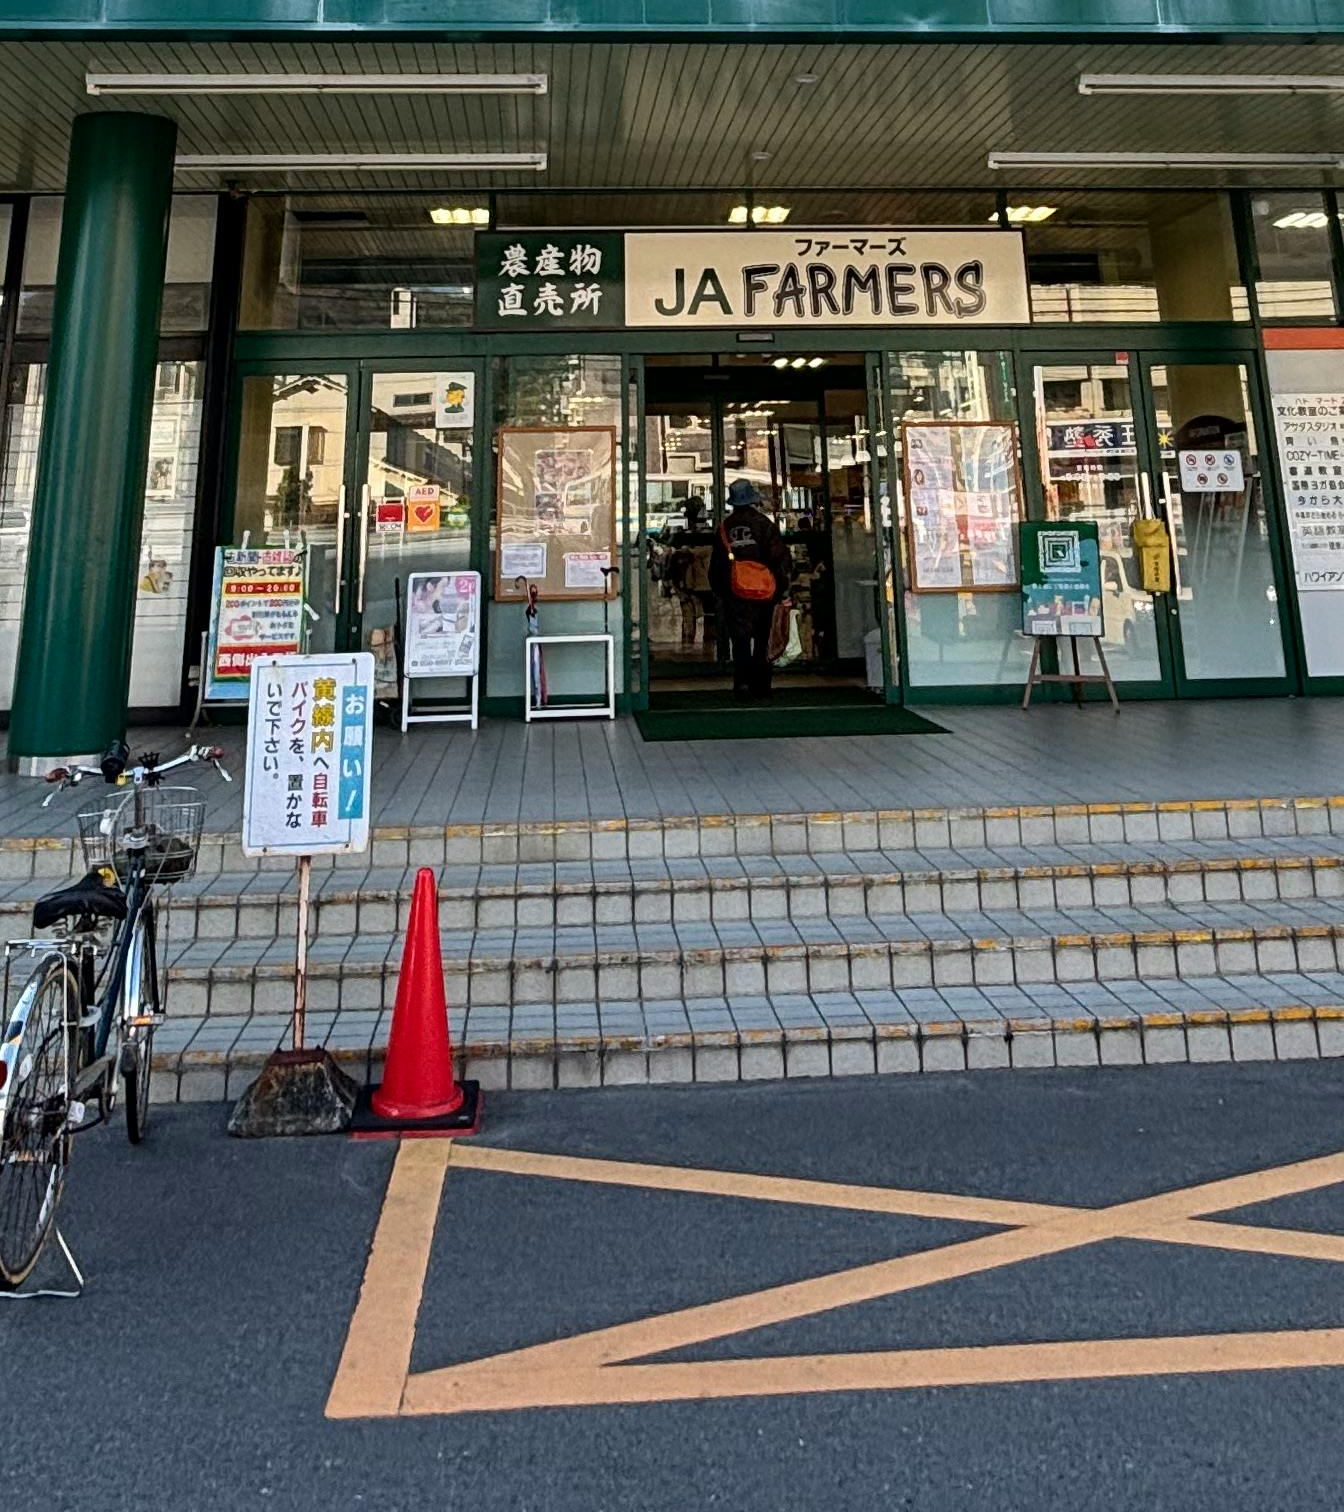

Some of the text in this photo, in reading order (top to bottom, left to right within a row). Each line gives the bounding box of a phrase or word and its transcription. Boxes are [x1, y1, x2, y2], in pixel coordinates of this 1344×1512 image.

[498, 244, 603, 277] 農産物
[794, 238, 907, 256] ファーマーズ
[497, 282, 603, 317] 直売所
[655, 261, 987, 318] JA FARMERS
[414, 487, 435, 495] AED
[263, 682, 282, 780] いで下さい。
[310, 677, 337, 827] 黄線内へ自転車
